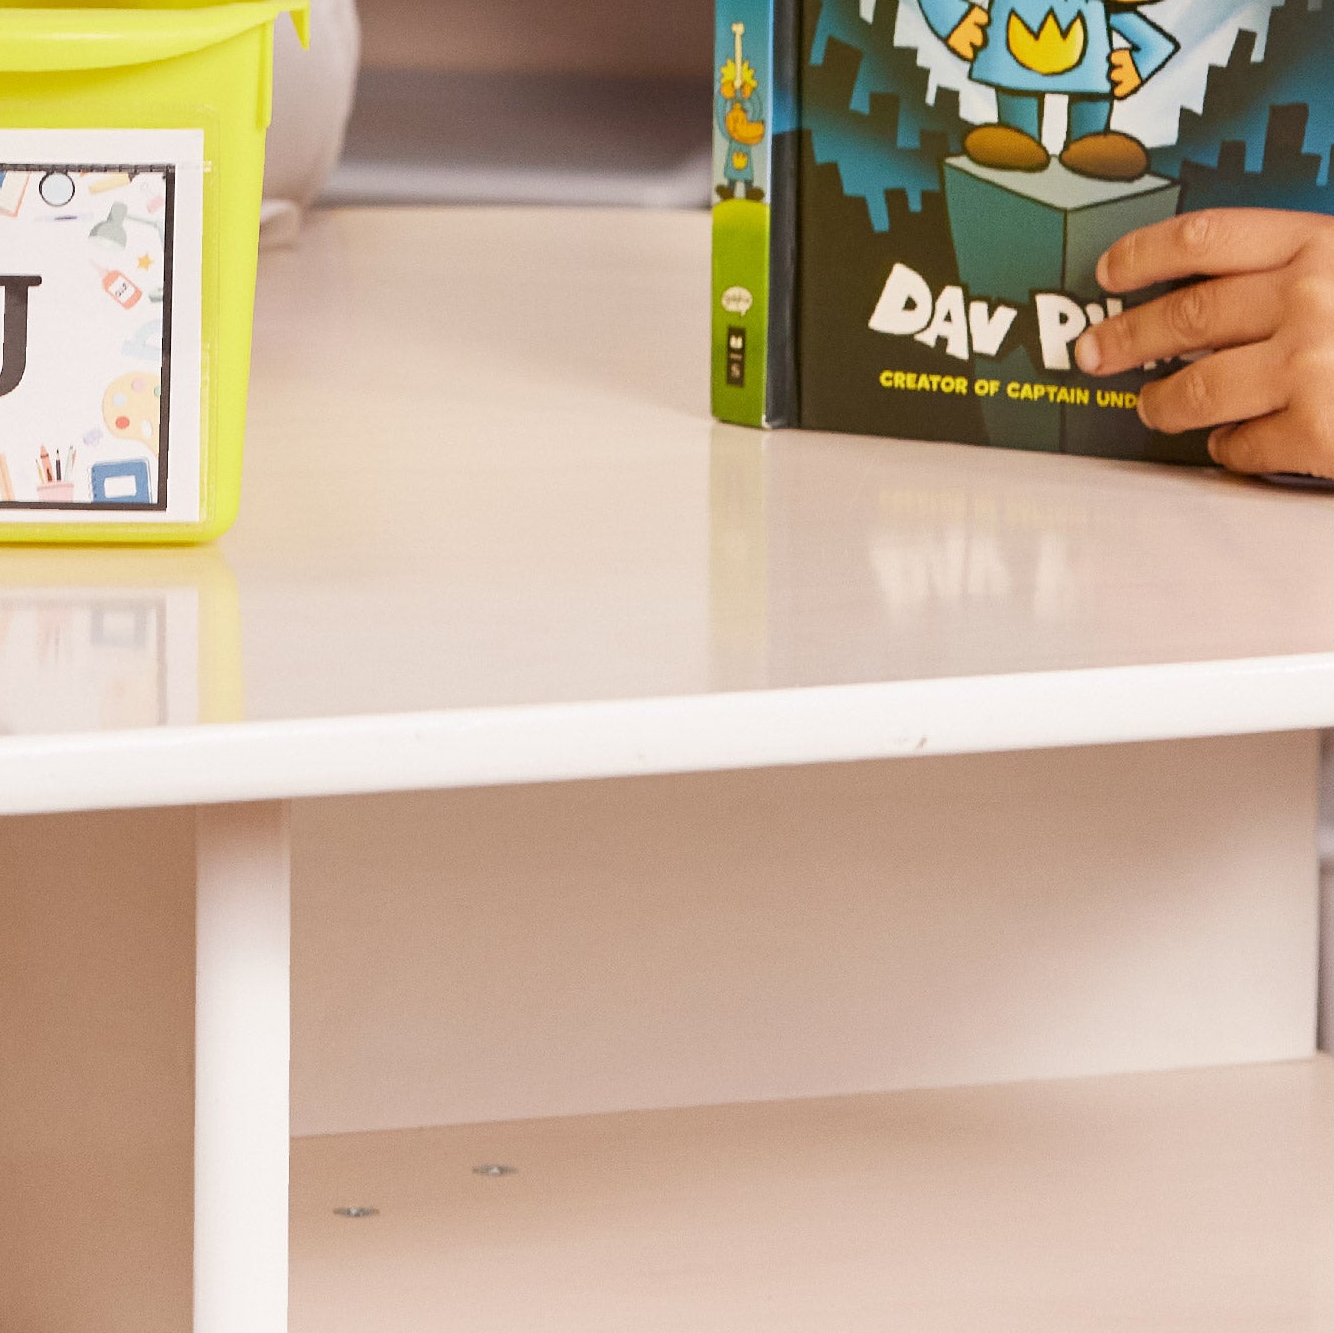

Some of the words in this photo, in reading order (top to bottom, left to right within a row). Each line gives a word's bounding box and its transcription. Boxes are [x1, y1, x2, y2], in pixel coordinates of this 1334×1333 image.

[868, 263, 1017, 361] DAV
[879, 369, 968, 395] CREATOR
[974, 379, 1001, 398] OF
[1006, 381, 1090, 406] CAPTAIN
